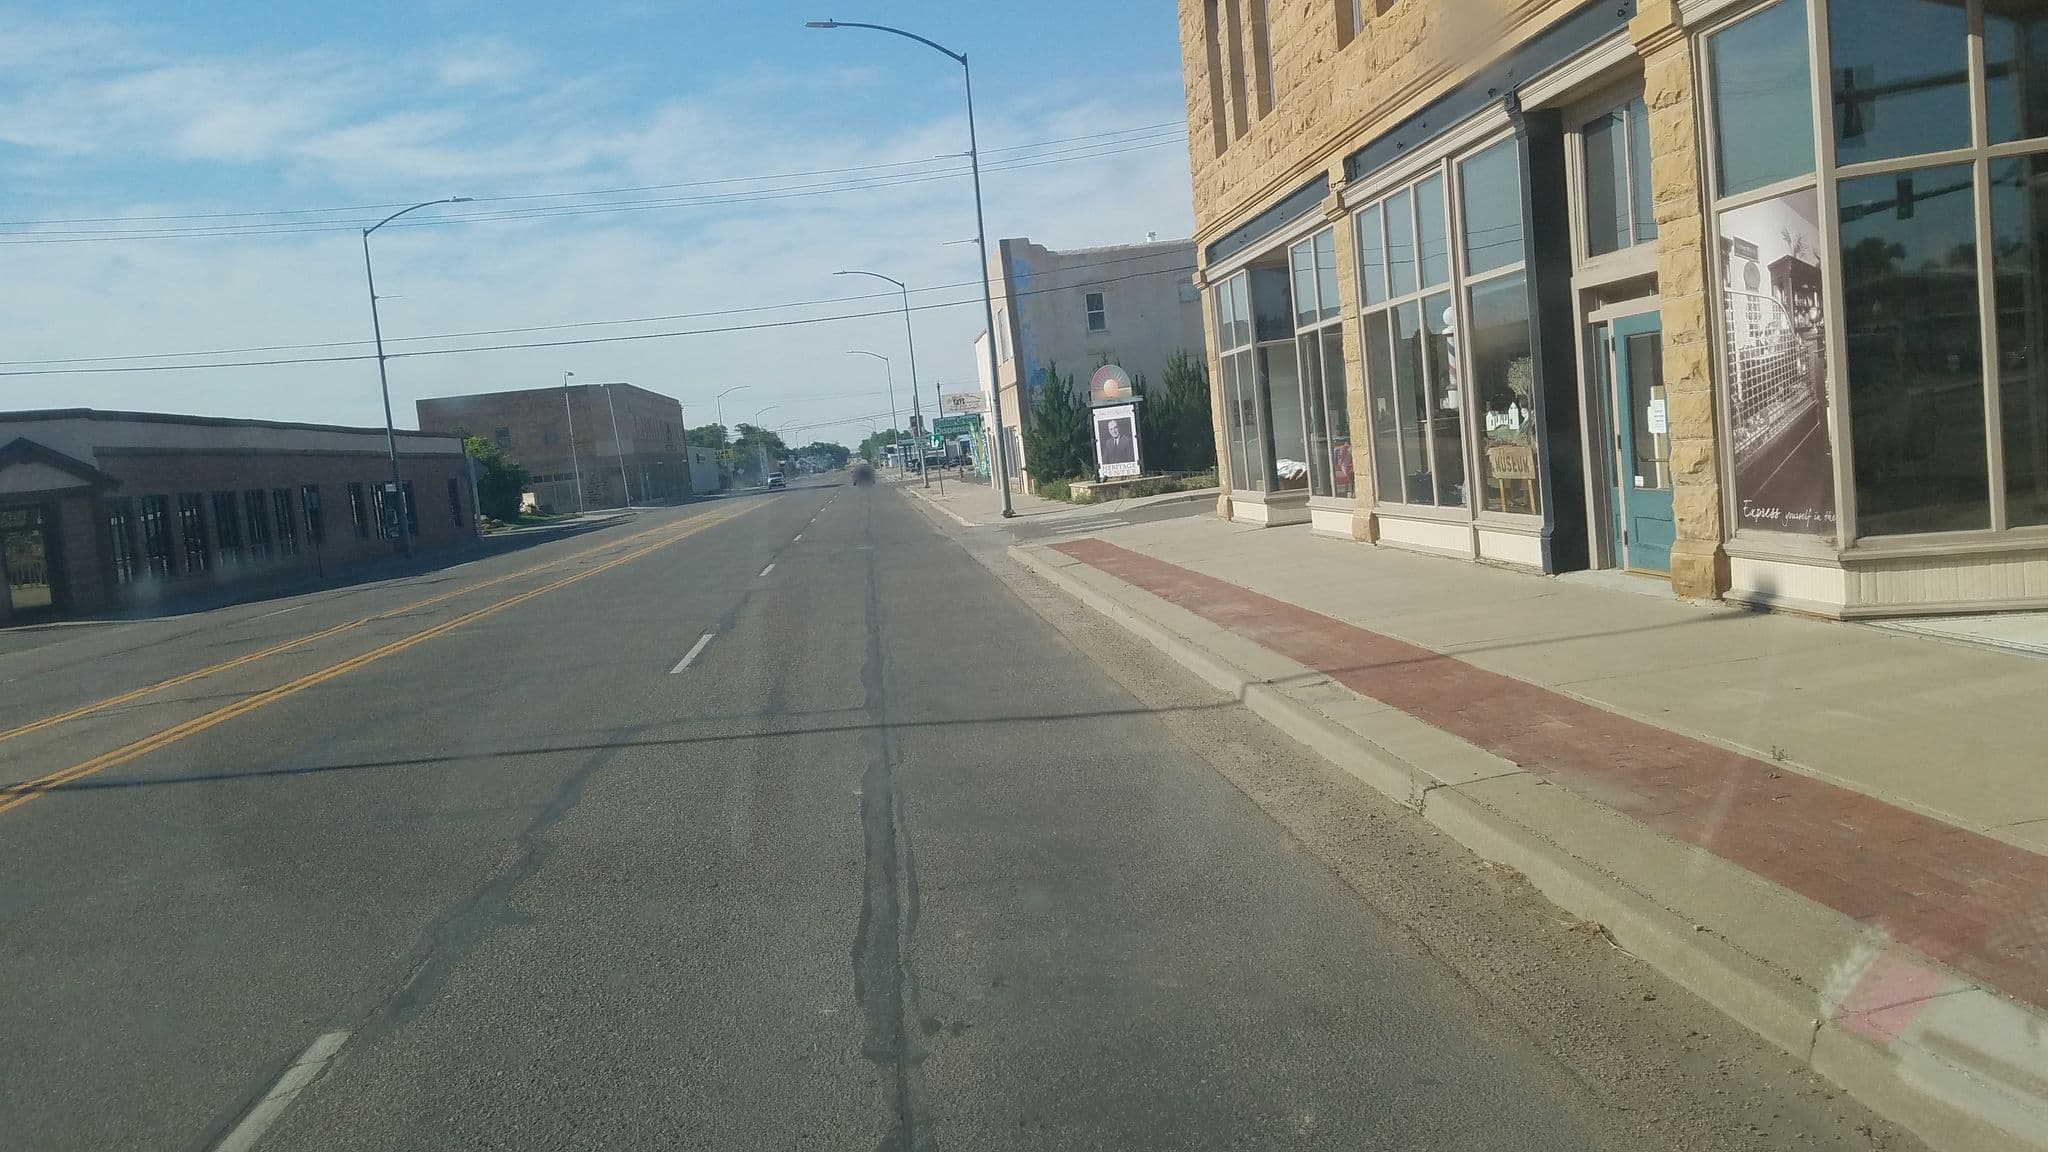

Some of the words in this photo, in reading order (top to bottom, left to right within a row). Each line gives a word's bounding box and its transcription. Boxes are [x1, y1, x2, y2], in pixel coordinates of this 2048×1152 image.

[1102, 463, 1136, 472] HERITAGE
[1494, 455, 1530, 473] MUSEUM
[1743, 500, 1780, 522] Express
[1782, 508, 1811, 527] yourself
